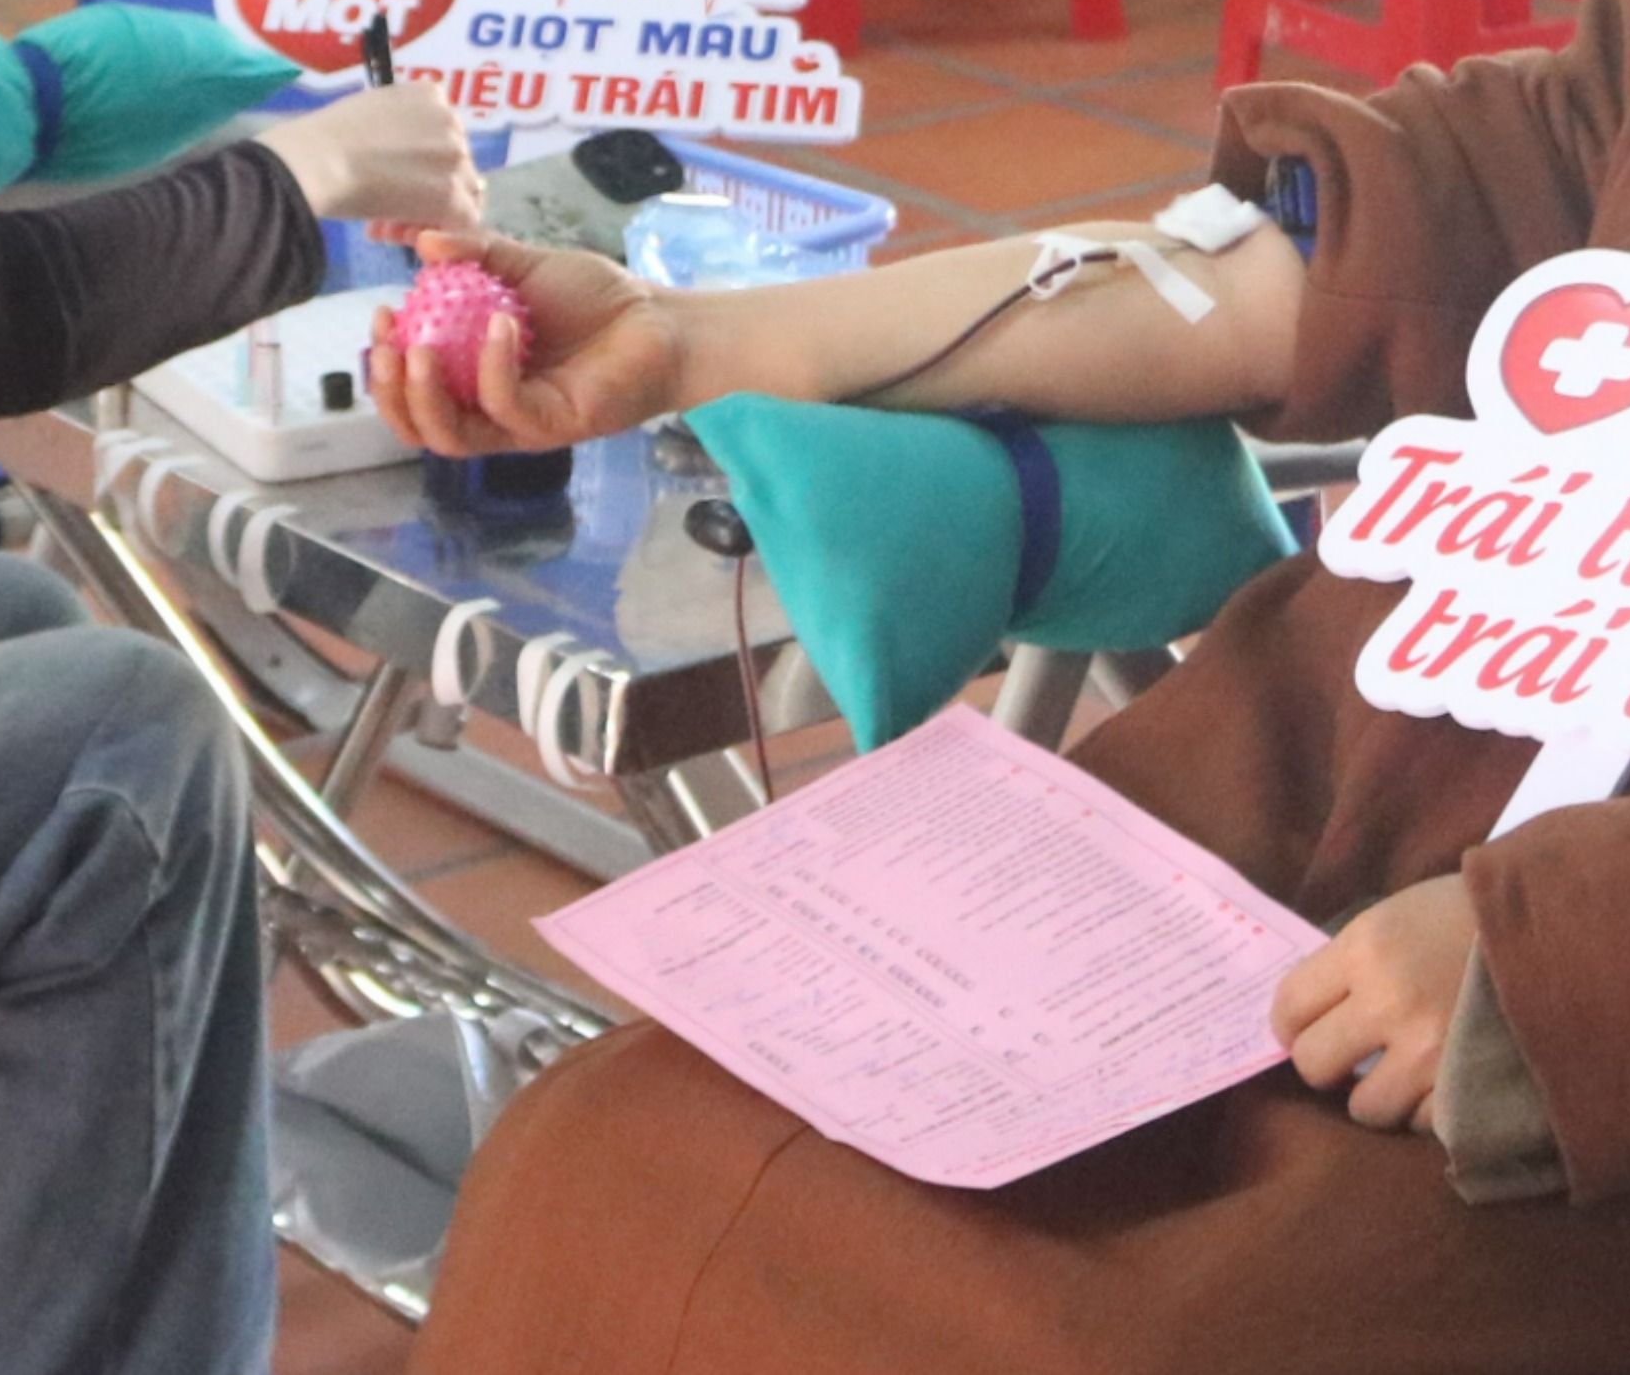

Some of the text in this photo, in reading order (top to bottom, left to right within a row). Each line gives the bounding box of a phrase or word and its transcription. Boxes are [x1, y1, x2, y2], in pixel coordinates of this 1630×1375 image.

[467, 12, 615, 62] GIỌT
[570, 70, 707, 121] TRÁI
[727, 82, 842, 127] TIM
[1349, 445, 1593, 567] Trái
